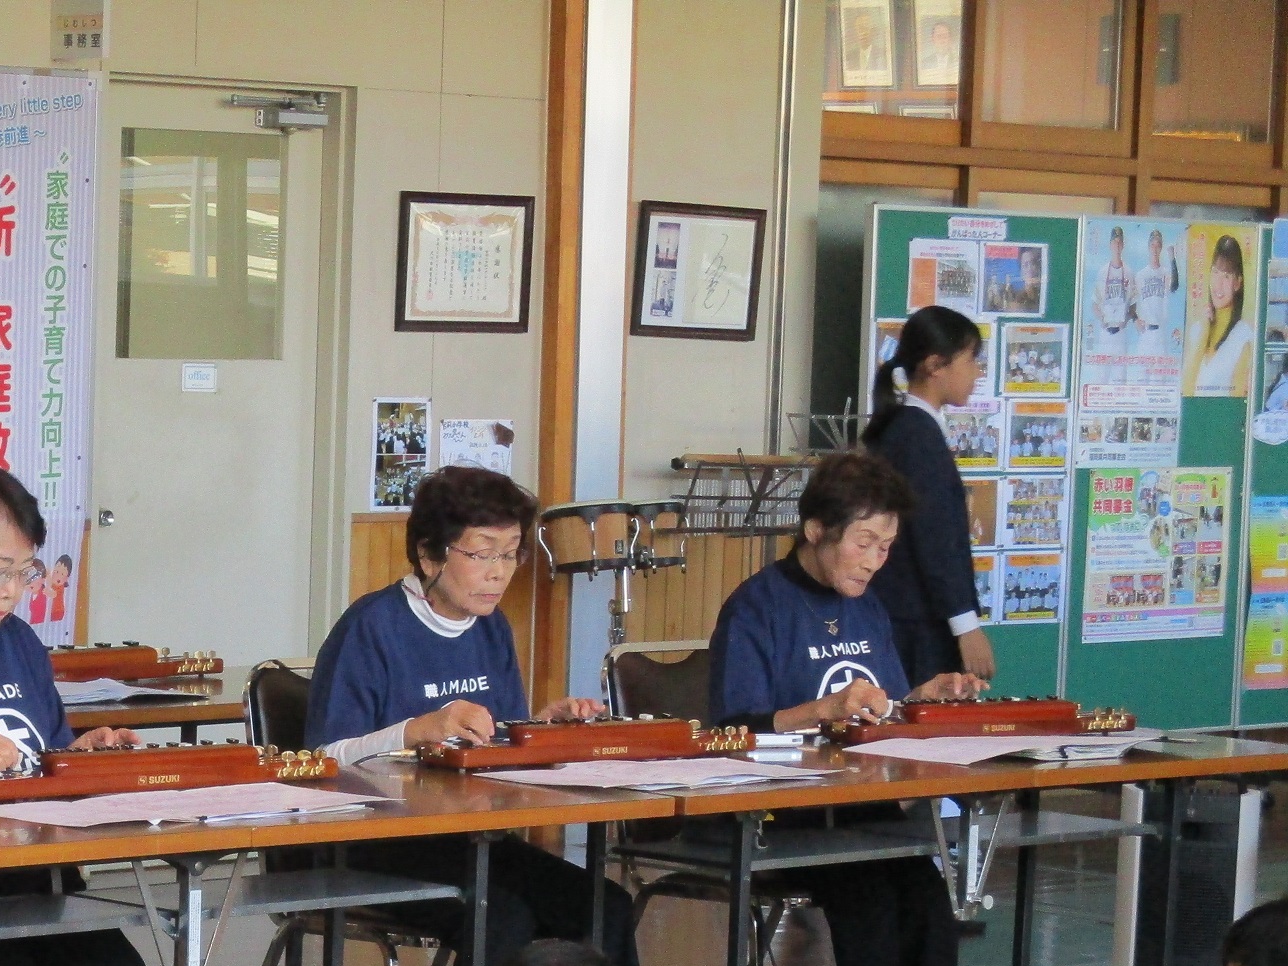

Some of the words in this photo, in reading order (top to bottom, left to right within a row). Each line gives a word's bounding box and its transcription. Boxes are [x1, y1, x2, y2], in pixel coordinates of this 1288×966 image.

[63, 33, 101, 49] 事務室
[21, 97, 49, 115] little
[53, 93, 84, 111] step
[149, 773, 181, 785] SUZUKI
